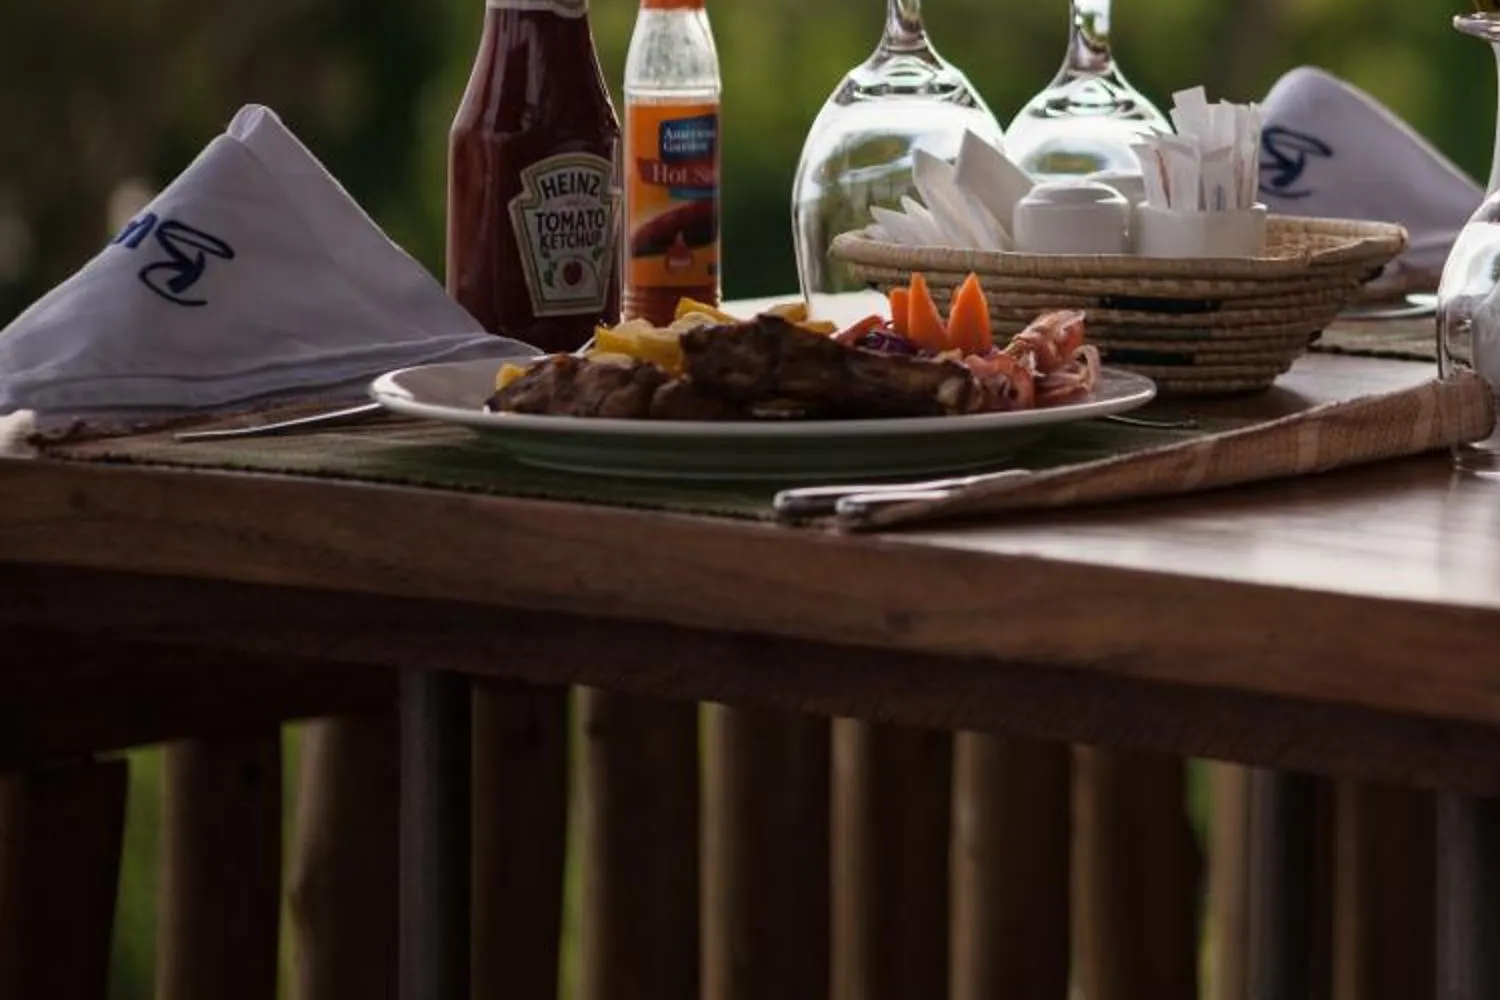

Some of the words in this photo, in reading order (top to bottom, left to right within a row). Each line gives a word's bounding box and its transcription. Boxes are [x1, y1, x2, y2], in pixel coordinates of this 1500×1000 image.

[540, 171, 601, 200] HEINZ
[653, 163, 687, 185] Hot
[534, 207, 606, 233] TOMATO
[540, 229, 603, 250] KETCHUP
